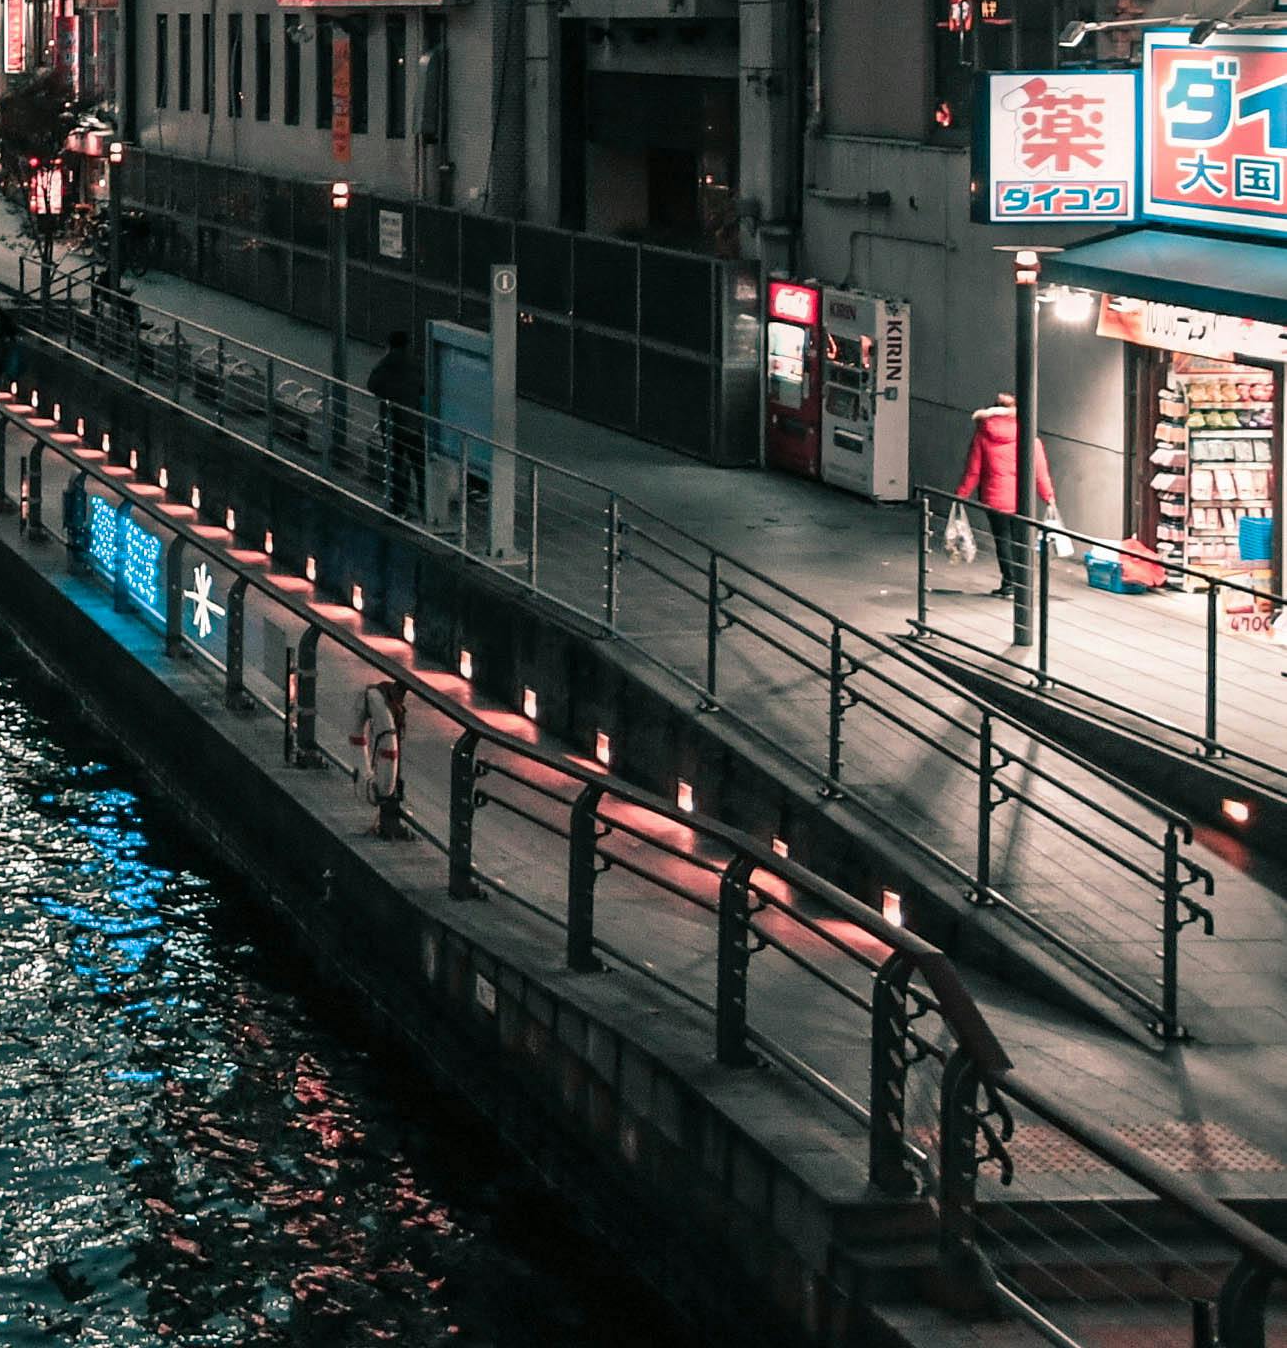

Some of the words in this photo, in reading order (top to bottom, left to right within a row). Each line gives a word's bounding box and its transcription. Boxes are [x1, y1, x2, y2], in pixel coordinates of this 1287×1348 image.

[1020, 94, 1106, 172] 薬
[1002, 186, 1122, 214] ダイコク
[1180, 154, 1281, 201] 大国
[886, 320, 903, 381] KIRIN
